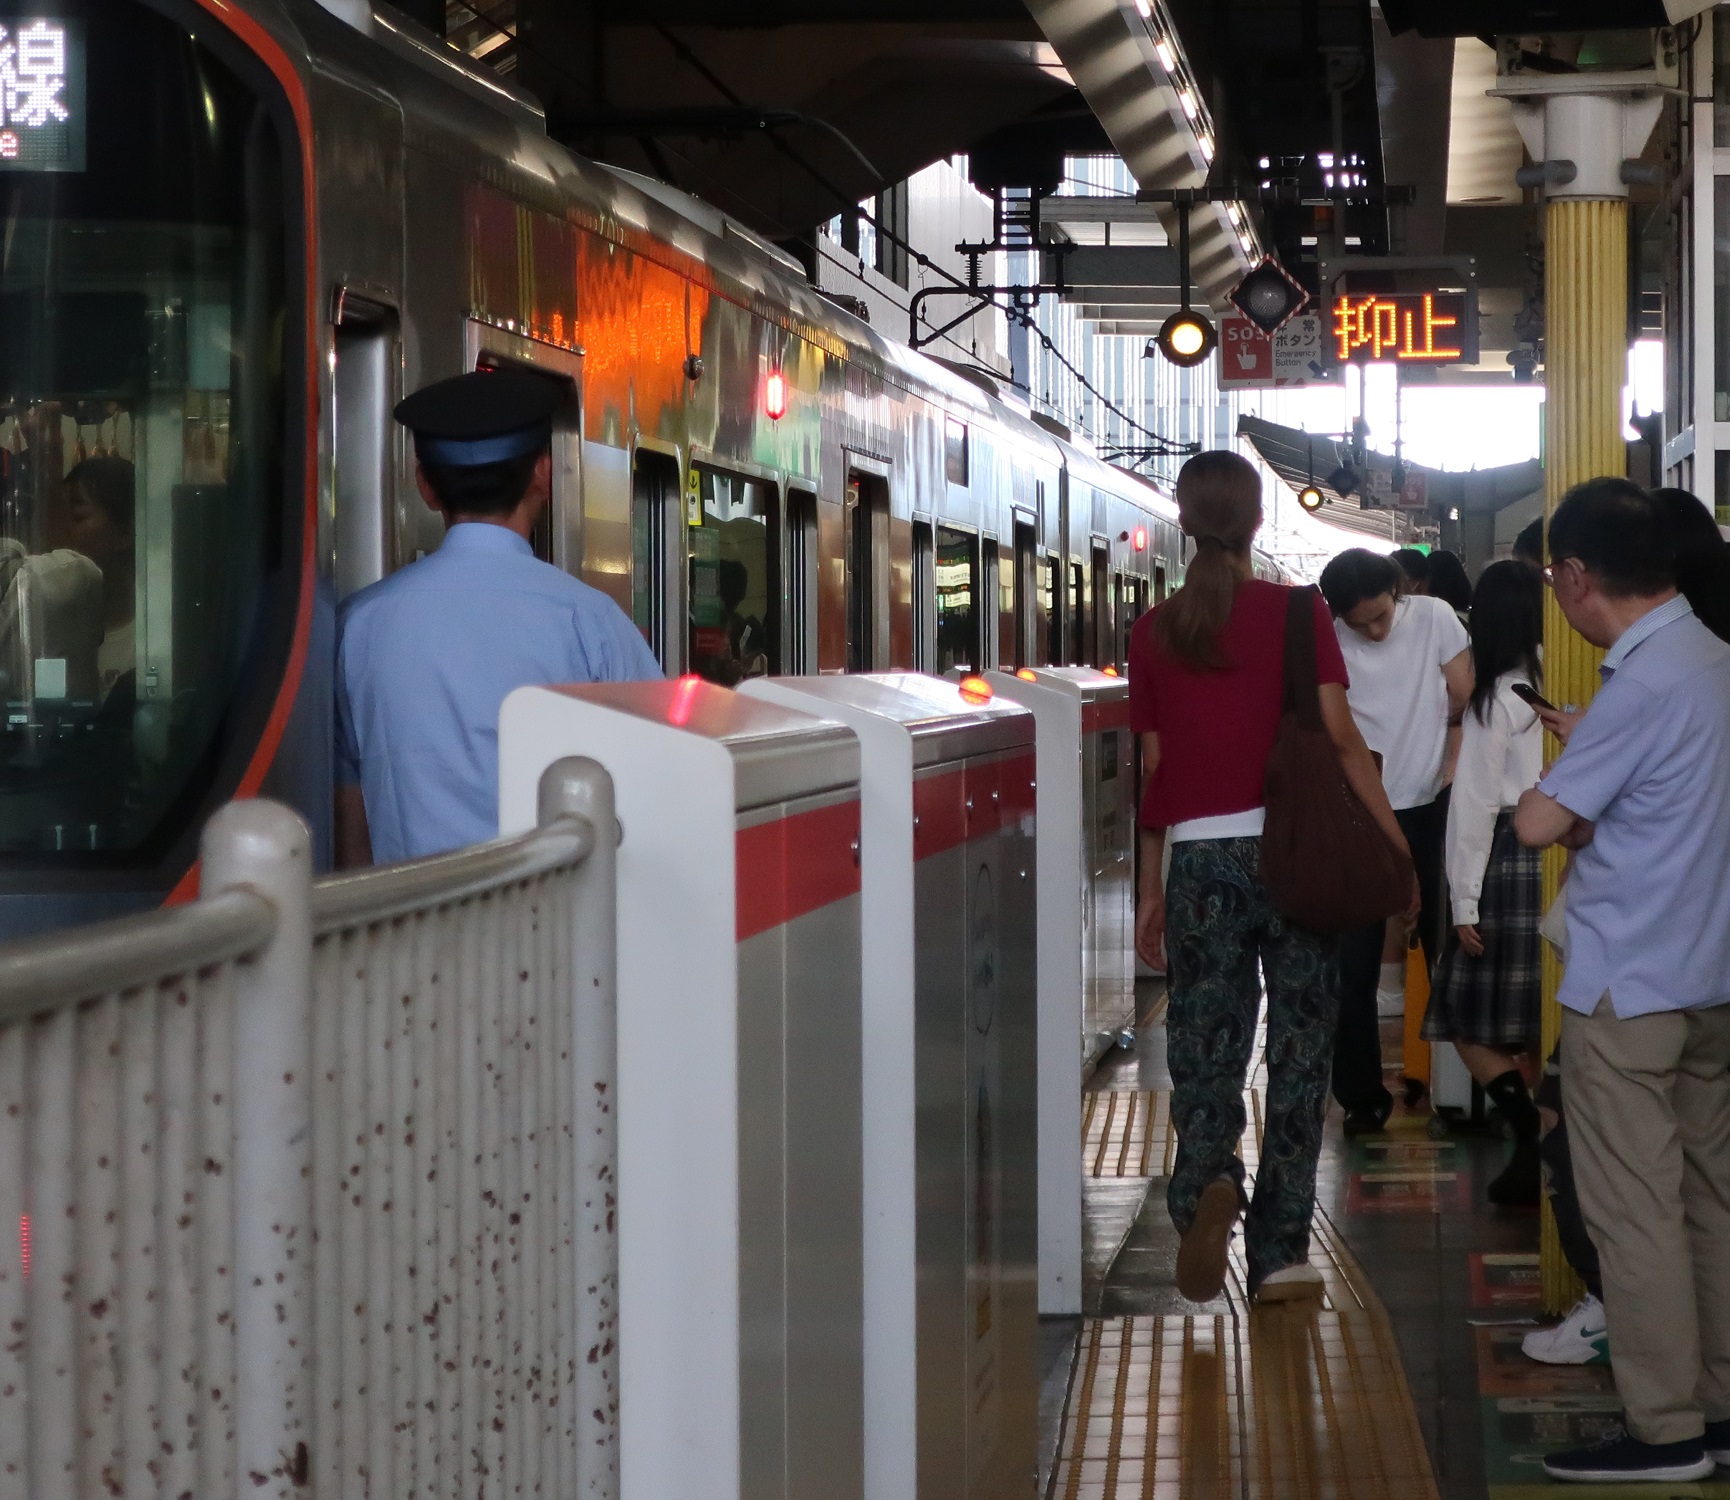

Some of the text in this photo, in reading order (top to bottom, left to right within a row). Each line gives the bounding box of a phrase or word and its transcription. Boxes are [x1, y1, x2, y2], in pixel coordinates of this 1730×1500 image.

[1332, 294, 1462, 360] 抑止
[1275, 334, 1316, 347] ボタン
[1275, 349, 1317, 359] Emergency
[1275, 358, 1302, 367] Button
